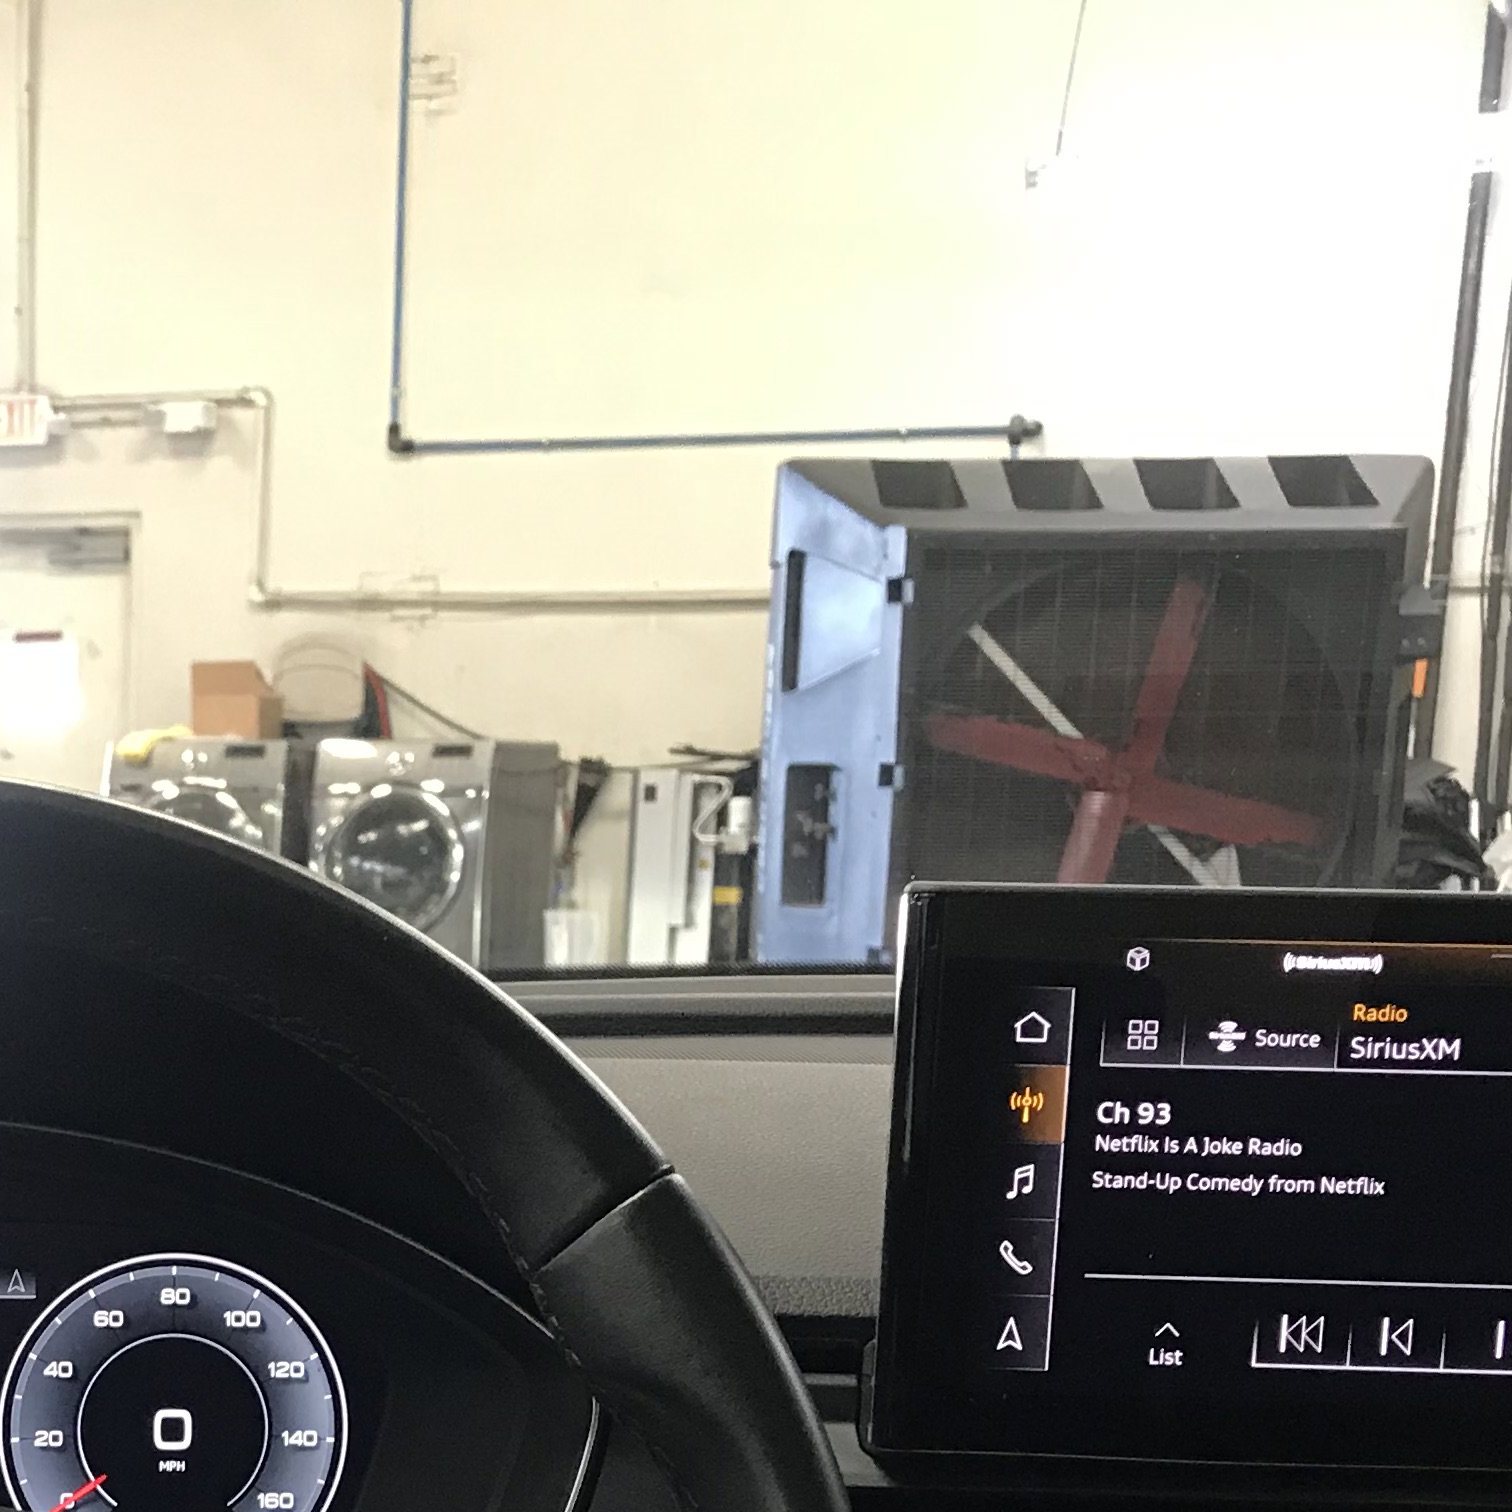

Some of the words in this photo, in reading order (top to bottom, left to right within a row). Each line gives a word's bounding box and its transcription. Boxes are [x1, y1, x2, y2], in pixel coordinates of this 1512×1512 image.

[1352, 1004, 1408, 1023] Radio
[1255, 1029, 1321, 1049] Source
[1350, 1037, 1461, 1062] SiriusXM
[1096, 1102, 1131, 1124] Ch
[1138, 1103, 1171, 1126] 93
[1094, 1134, 1159, 1154] Netflix
[1164, 1136, 1180, 1154] Is
[1184, 1136, 1199, 1155] A
[1202, 1136, 1243, 1156] Joke
[1248, 1138, 1303, 1158] Radio
[1091, 1172, 1182, 1193] Stand-Up
[1187, 1173, 1263, 1196] Comedy
[1268, 1175, 1315, 1193] from
[1319, 1176, 1386, 1196] Netflix
[160, 1288, 191, 1305] 80
[93, 1310, 124, 1328] 60
[223, 1310, 261, 1328] 100
[1148, 1348, 1183, 1366] List
[43, 1361, 73, 1379] 40
[267, 1361, 305, 1379] 120
[34, 1430, 63, 1448] 20
[281, 1430, 318, 1447] 140
[159, 1460, 186, 1473] MPH
[256, 1492, 294, 1510] 160
